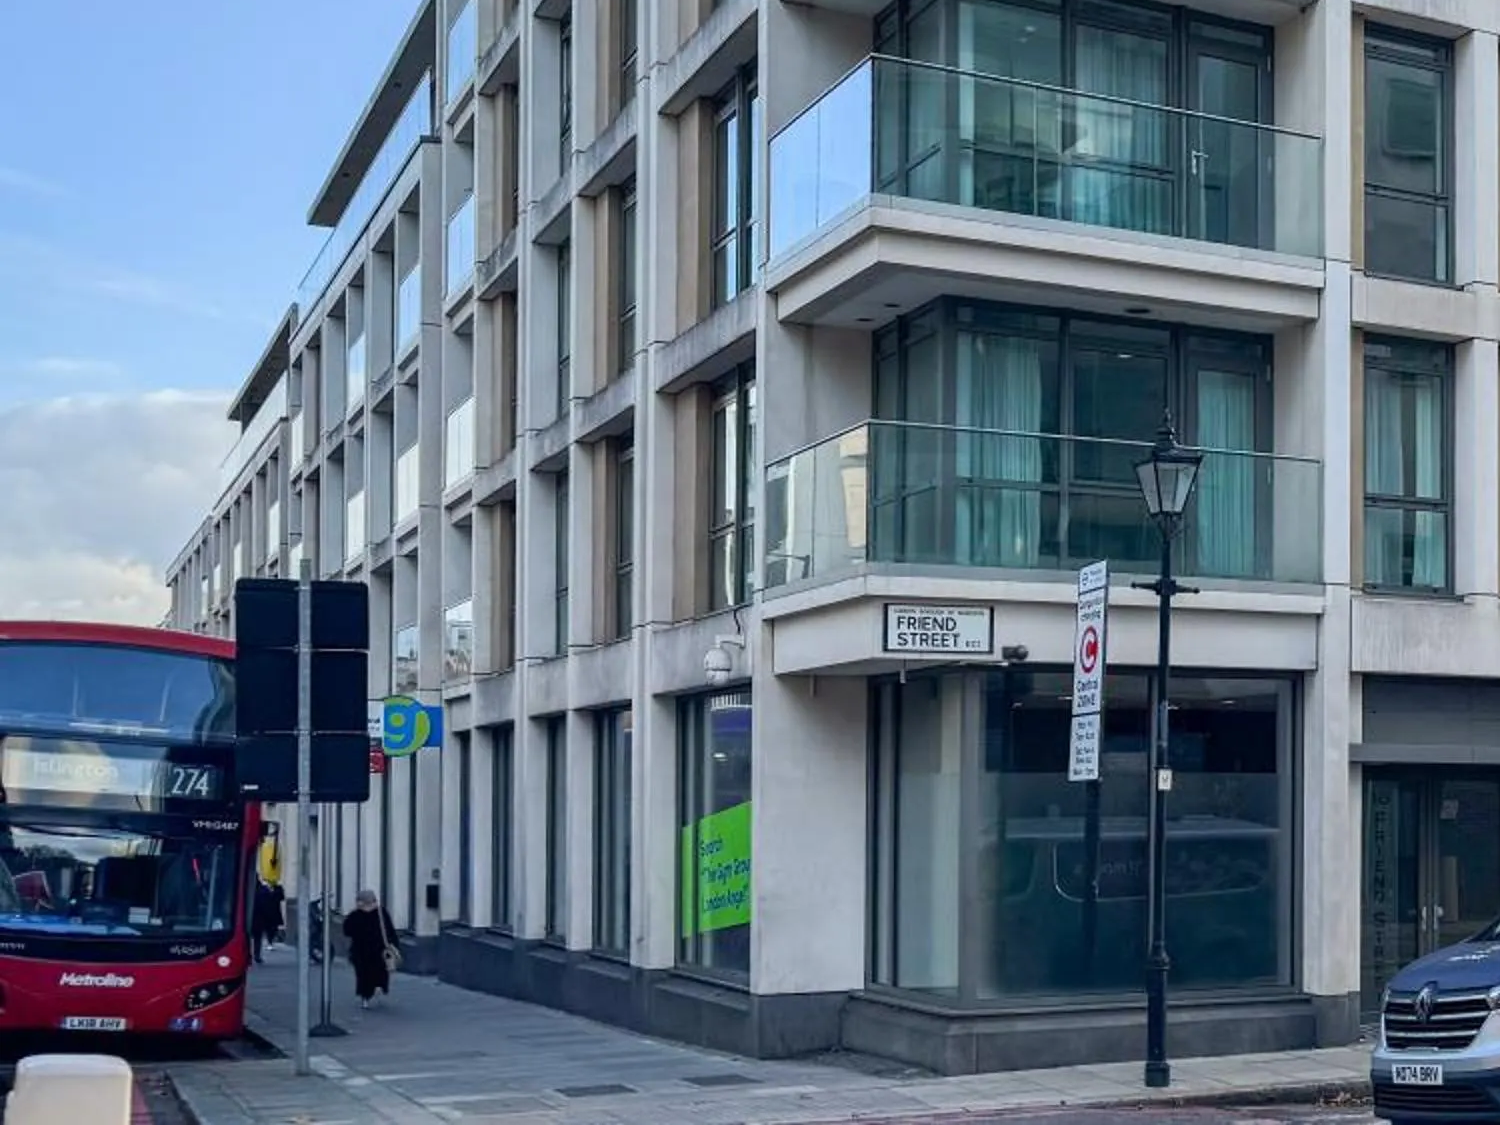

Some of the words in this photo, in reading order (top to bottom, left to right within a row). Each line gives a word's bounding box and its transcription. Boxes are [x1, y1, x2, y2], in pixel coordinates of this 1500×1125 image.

[897, 616, 957, 632] FRIEND
[897, 632, 961, 648] STREET
[171, 767, 210, 796] 274
[59, 972, 135, 988] Metroline
